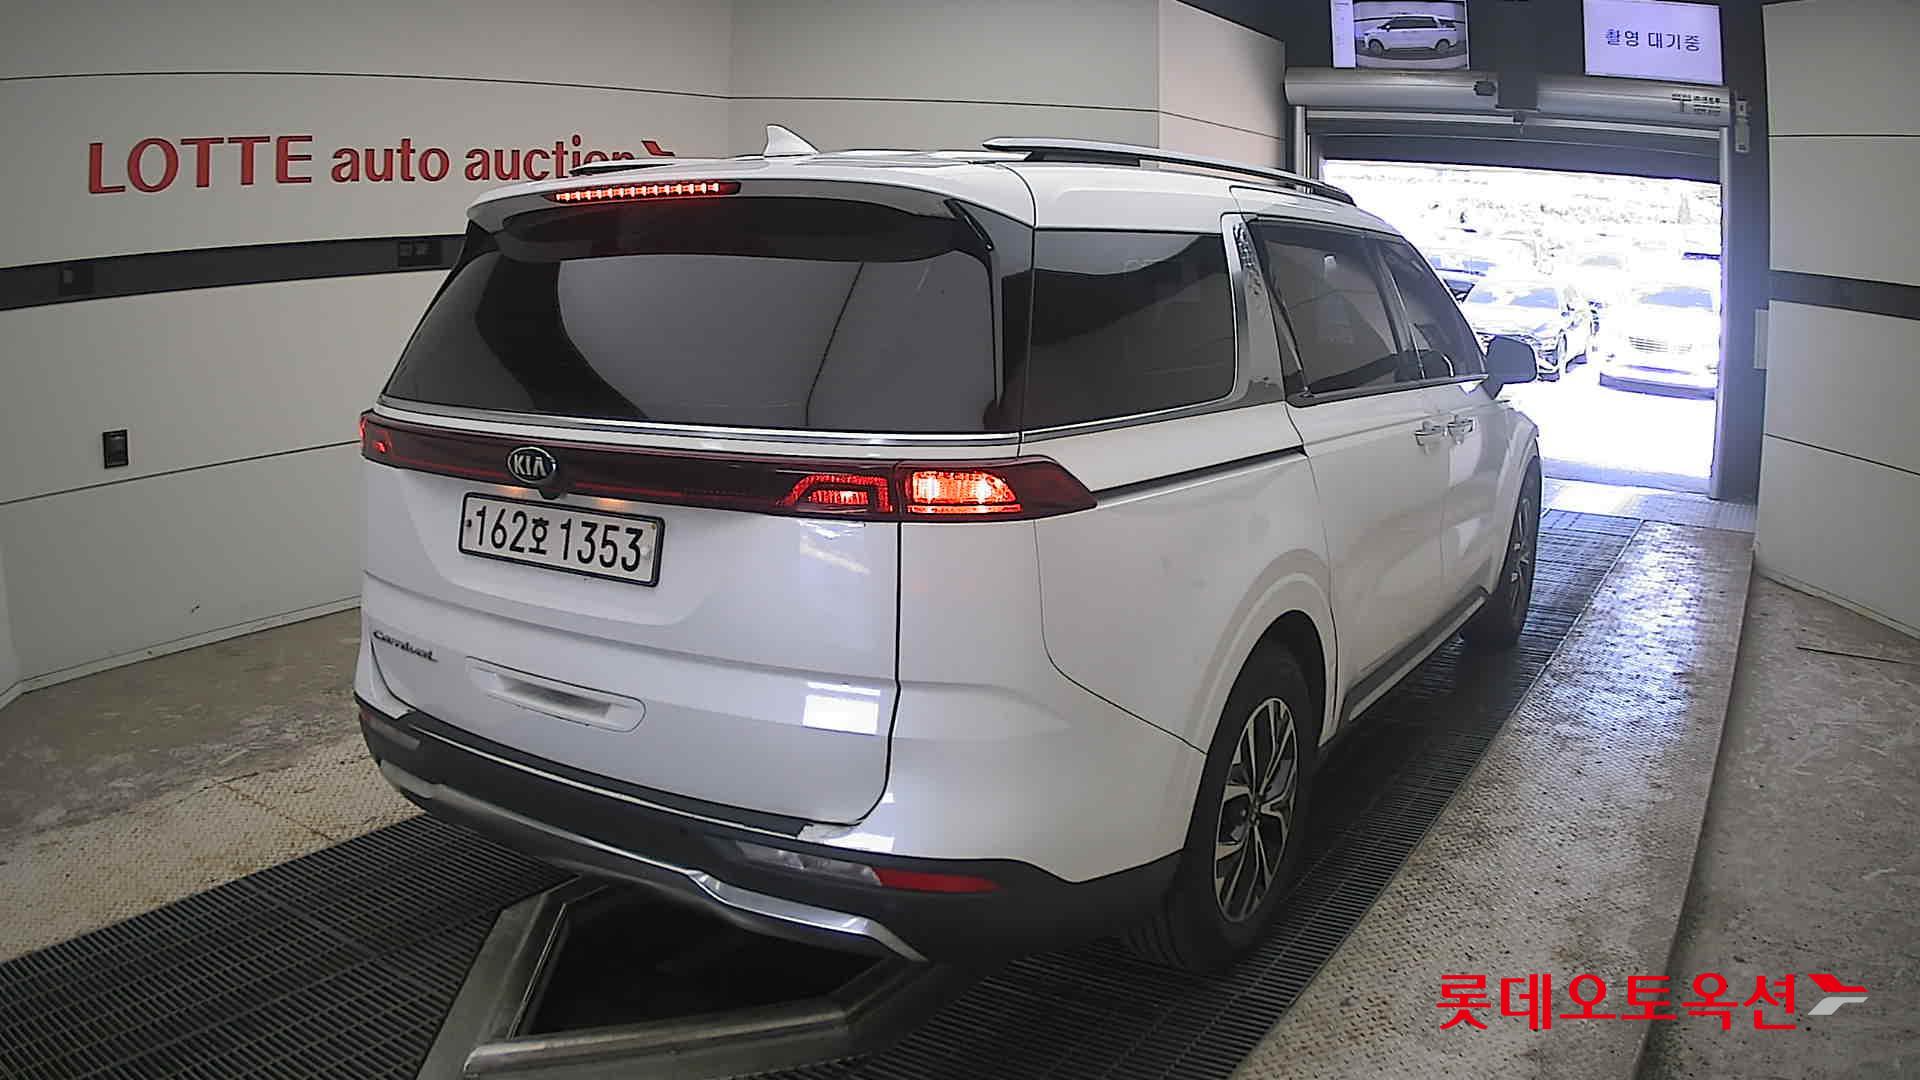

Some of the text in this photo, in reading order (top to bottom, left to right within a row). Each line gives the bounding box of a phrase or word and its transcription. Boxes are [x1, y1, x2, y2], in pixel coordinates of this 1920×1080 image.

[1606, 29, 1700, 52] 촬영 대기중
[88, 134, 636, 194] LOTTE auto aucti
[513, 454, 547, 477] KIA
[476, 505, 645, 572] 162호 1353
